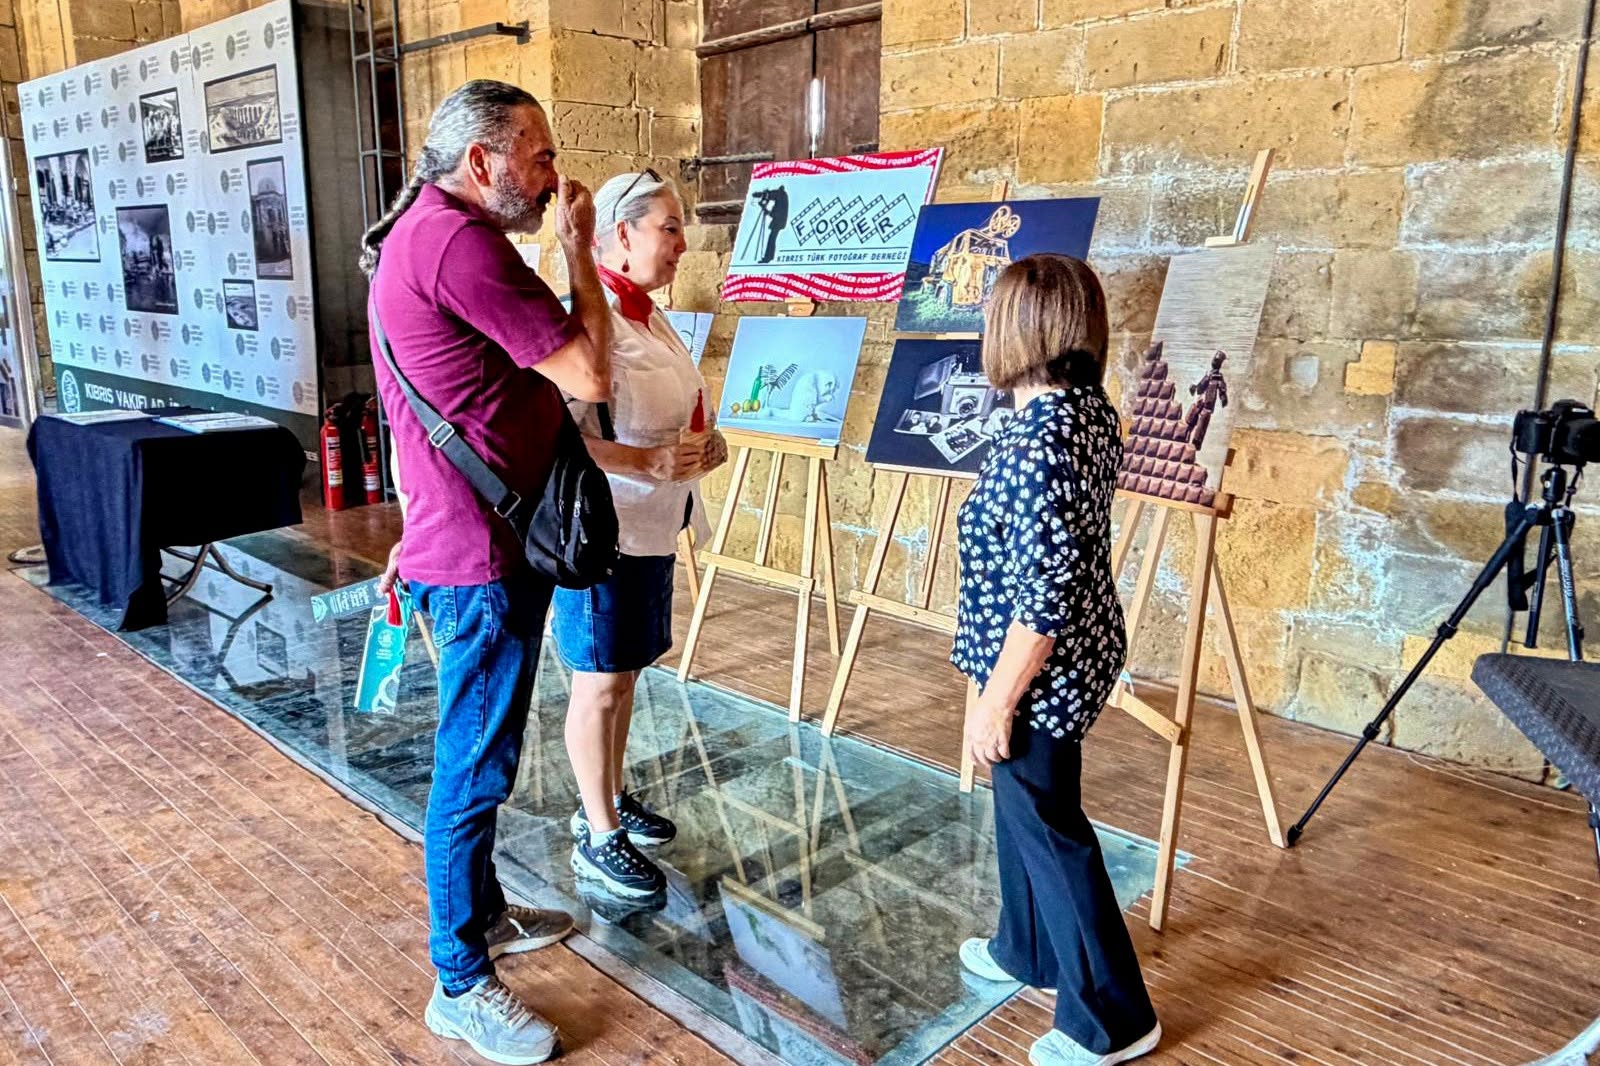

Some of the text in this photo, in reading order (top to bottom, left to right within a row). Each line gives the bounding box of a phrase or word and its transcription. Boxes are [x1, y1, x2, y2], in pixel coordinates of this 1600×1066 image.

[796, 216, 894, 237] FODER
[807, 252, 825, 262] TÜRK
[828, 252, 868, 262] FOTOĞRAF
[871, 250, 907, 261] DERNEĞİ
[84, 383, 114, 404] KIBRIS
